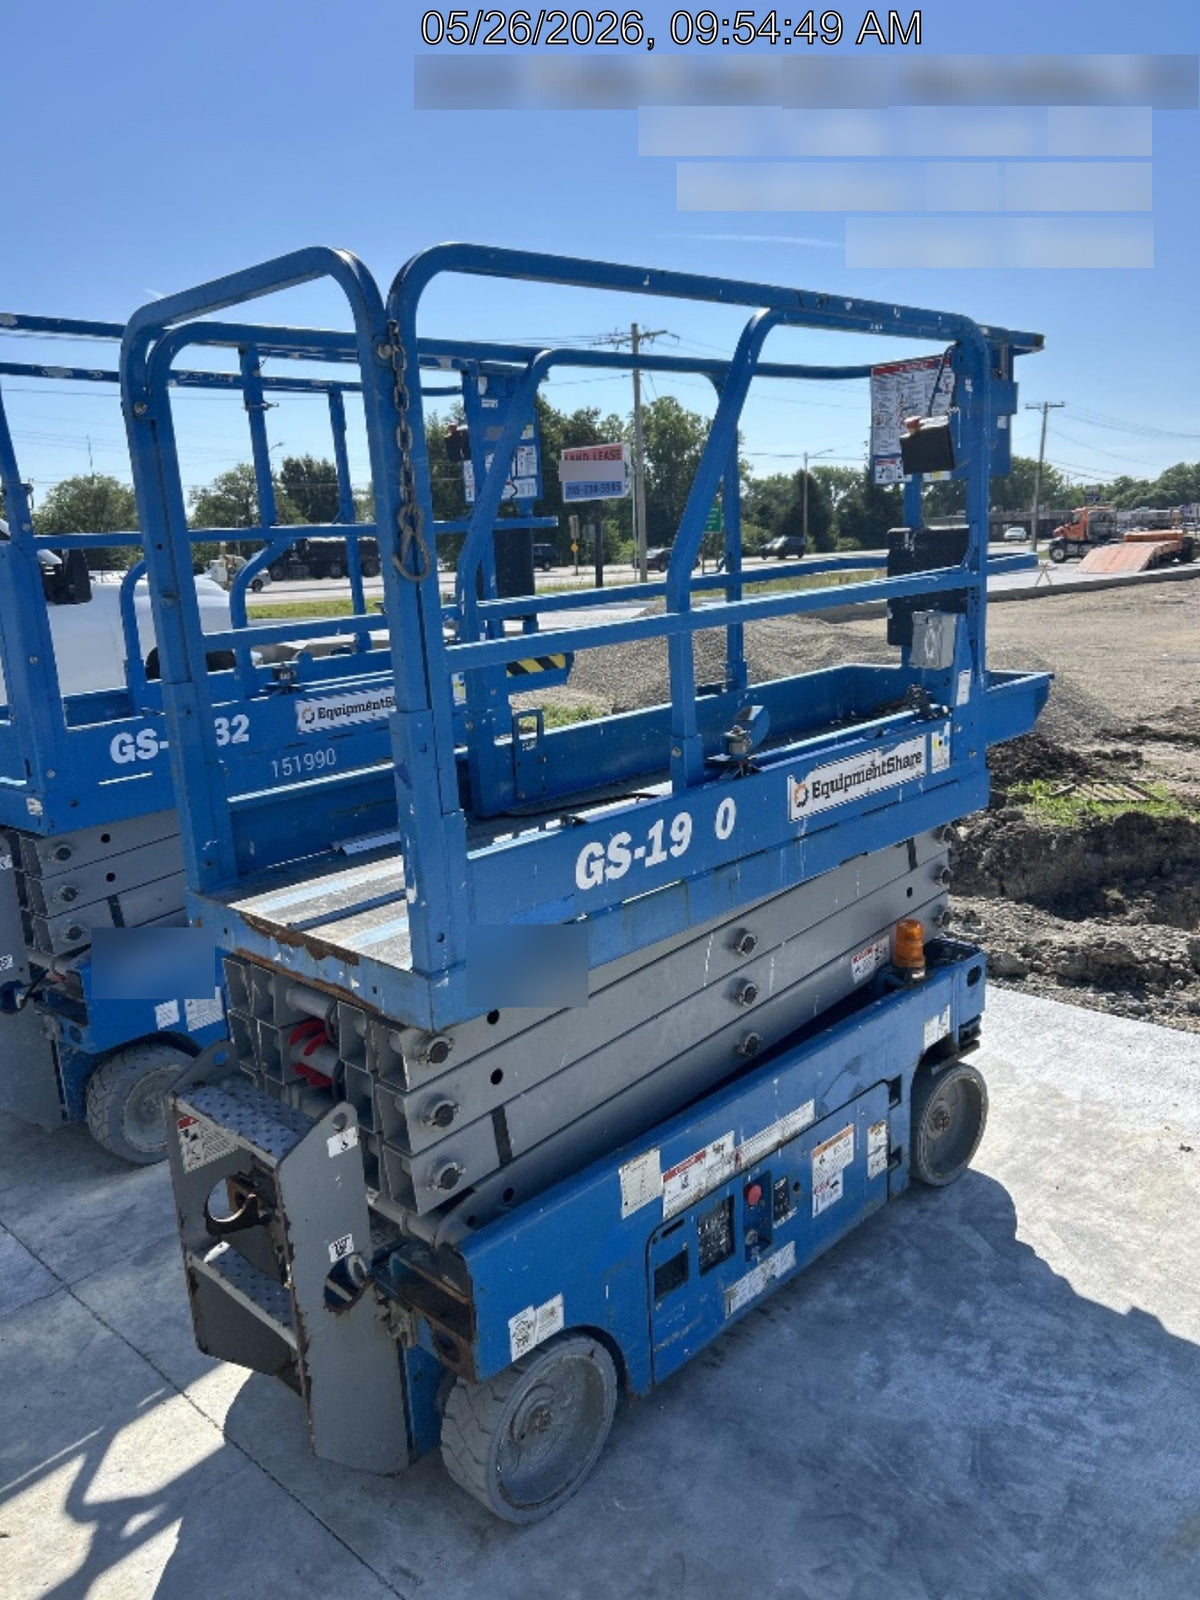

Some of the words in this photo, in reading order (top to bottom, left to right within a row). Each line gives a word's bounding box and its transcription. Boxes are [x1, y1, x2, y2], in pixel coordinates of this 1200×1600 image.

[318, 696, 397, 720] EquipmentS
[271, 748, 337, 779] 151990
[812, 751, 922, 799] EquipmentShare
